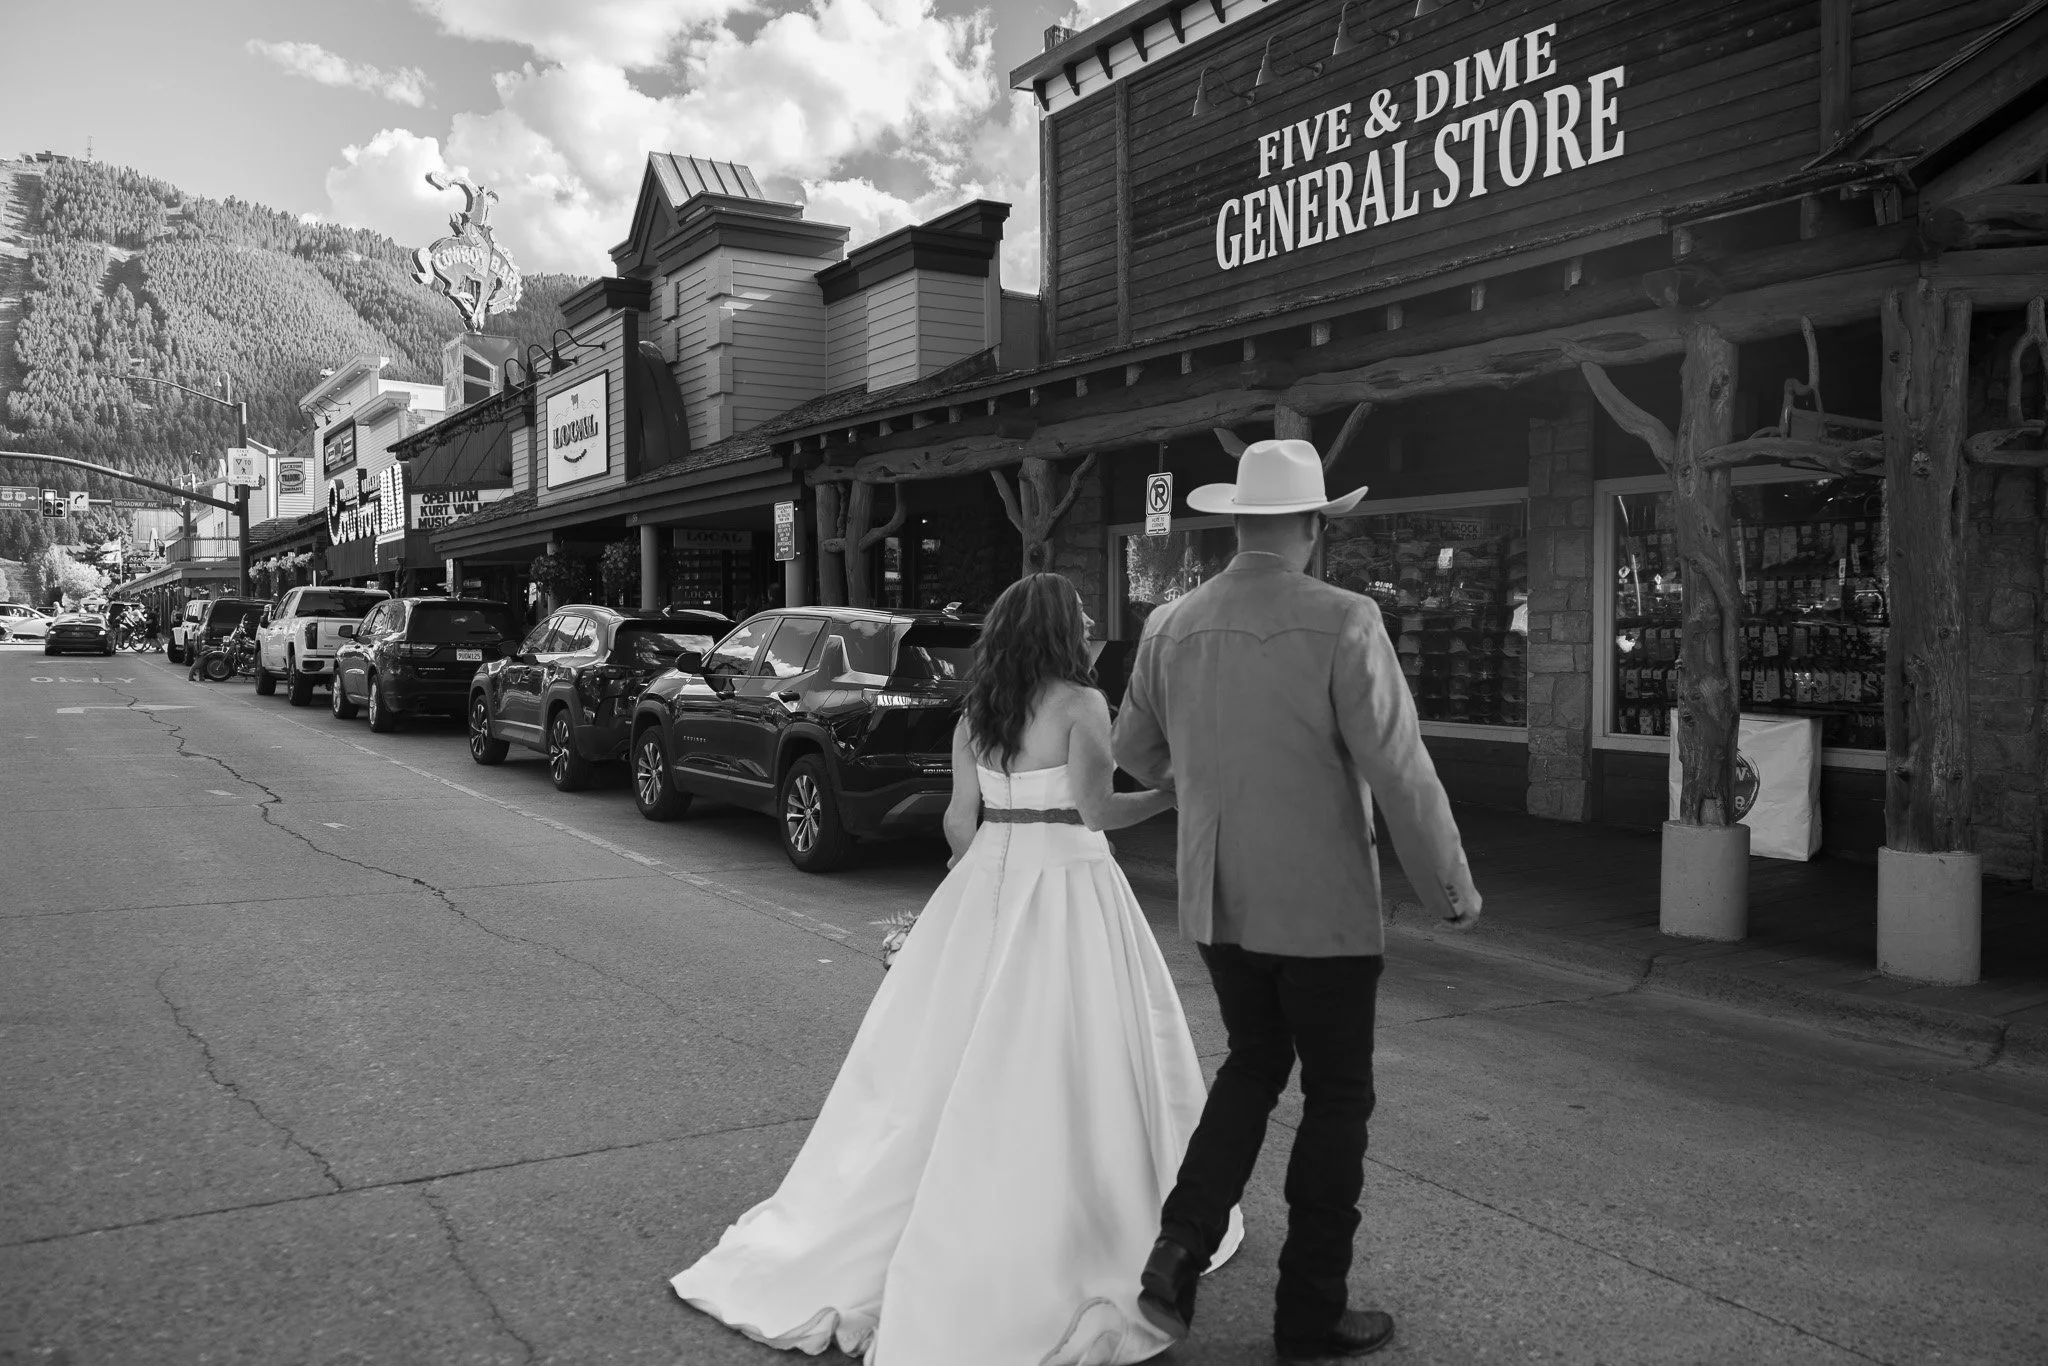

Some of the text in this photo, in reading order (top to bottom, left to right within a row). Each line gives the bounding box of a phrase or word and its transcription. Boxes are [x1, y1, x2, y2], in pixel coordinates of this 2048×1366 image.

[1257, 22, 1557, 180] FIVE & DIME
[1215, 65, 1625, 271] GENERAL STORE
[434, 246, 517, 292] COWBOY BAR
[553, 413, 598, 450] LOCAL
[422, 491, 450, 504] OPEN
[420, 504, 449, 517] KURT
[453, 503, 474, 514] VAN
[418, 516, 453, 528] MUSIC
[686, 531, 743, 542] LOCAL
[684, 591, 722, 599] LOCAL
[30, 676, 136, 684] ONLY
